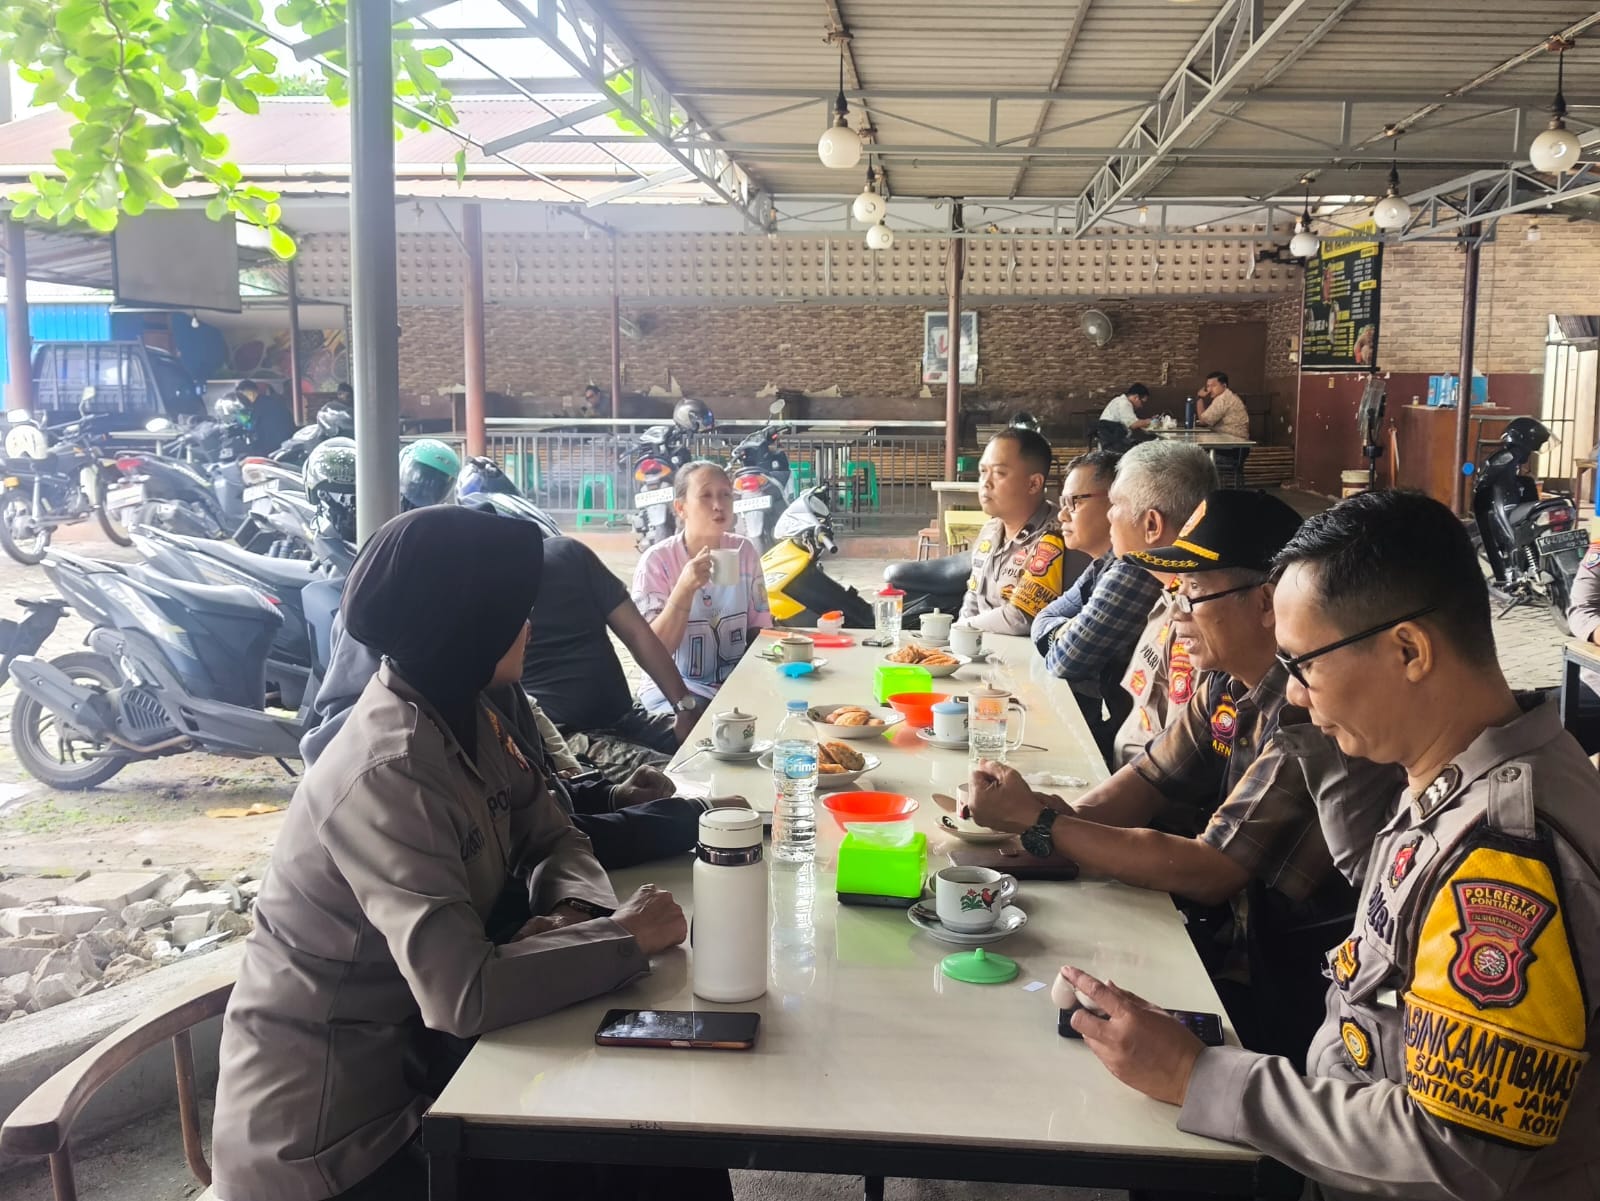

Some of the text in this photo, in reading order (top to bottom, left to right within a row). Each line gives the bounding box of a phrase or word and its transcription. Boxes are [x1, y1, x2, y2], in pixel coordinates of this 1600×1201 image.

[1465, 887, 1538, 916] POLRESTA
[1470, 897, 1531, 918] PONTIANAK
[1414, 1053, 1500, 1100] SUNGAI
[1406, 1070, 1508, 1123] PONTIANAK
